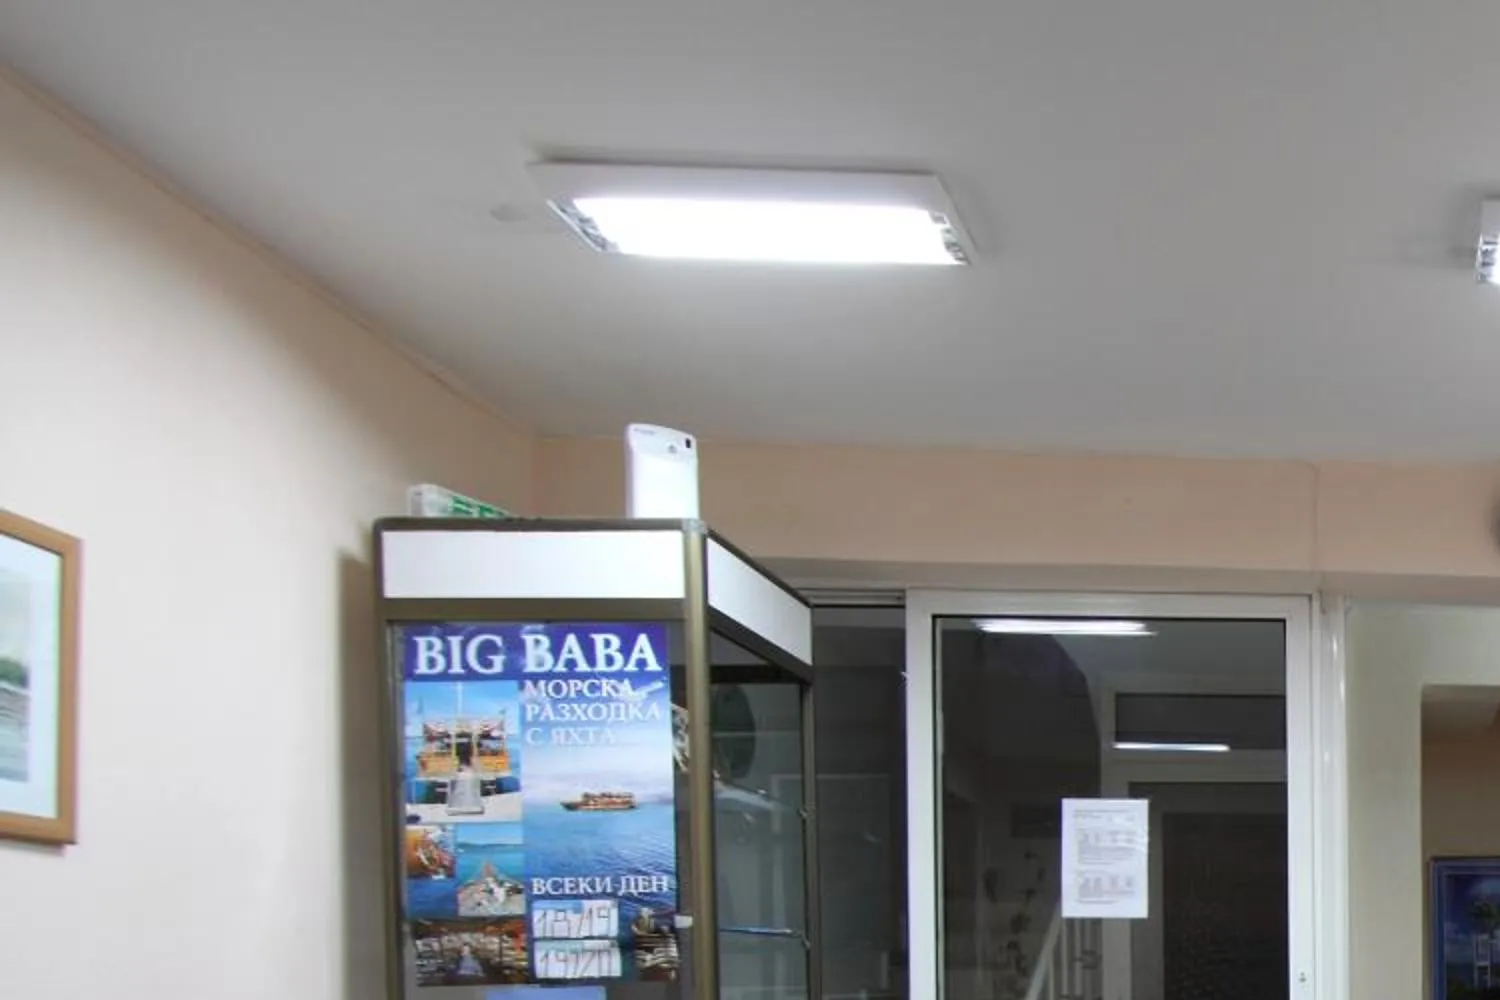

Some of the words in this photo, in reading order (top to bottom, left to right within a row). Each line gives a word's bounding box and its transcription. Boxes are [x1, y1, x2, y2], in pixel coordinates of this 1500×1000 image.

[413, 634, 506, 675] BIG
[520, 632, 663, 674] BABA
[523, 679, 634, 699] МОРСКА
[525, 702, 662, 724] РАЗХОДКА
[531, 876, 612, 895] ВСЕКИ
[617, 875, 670, 896] ДЕН
